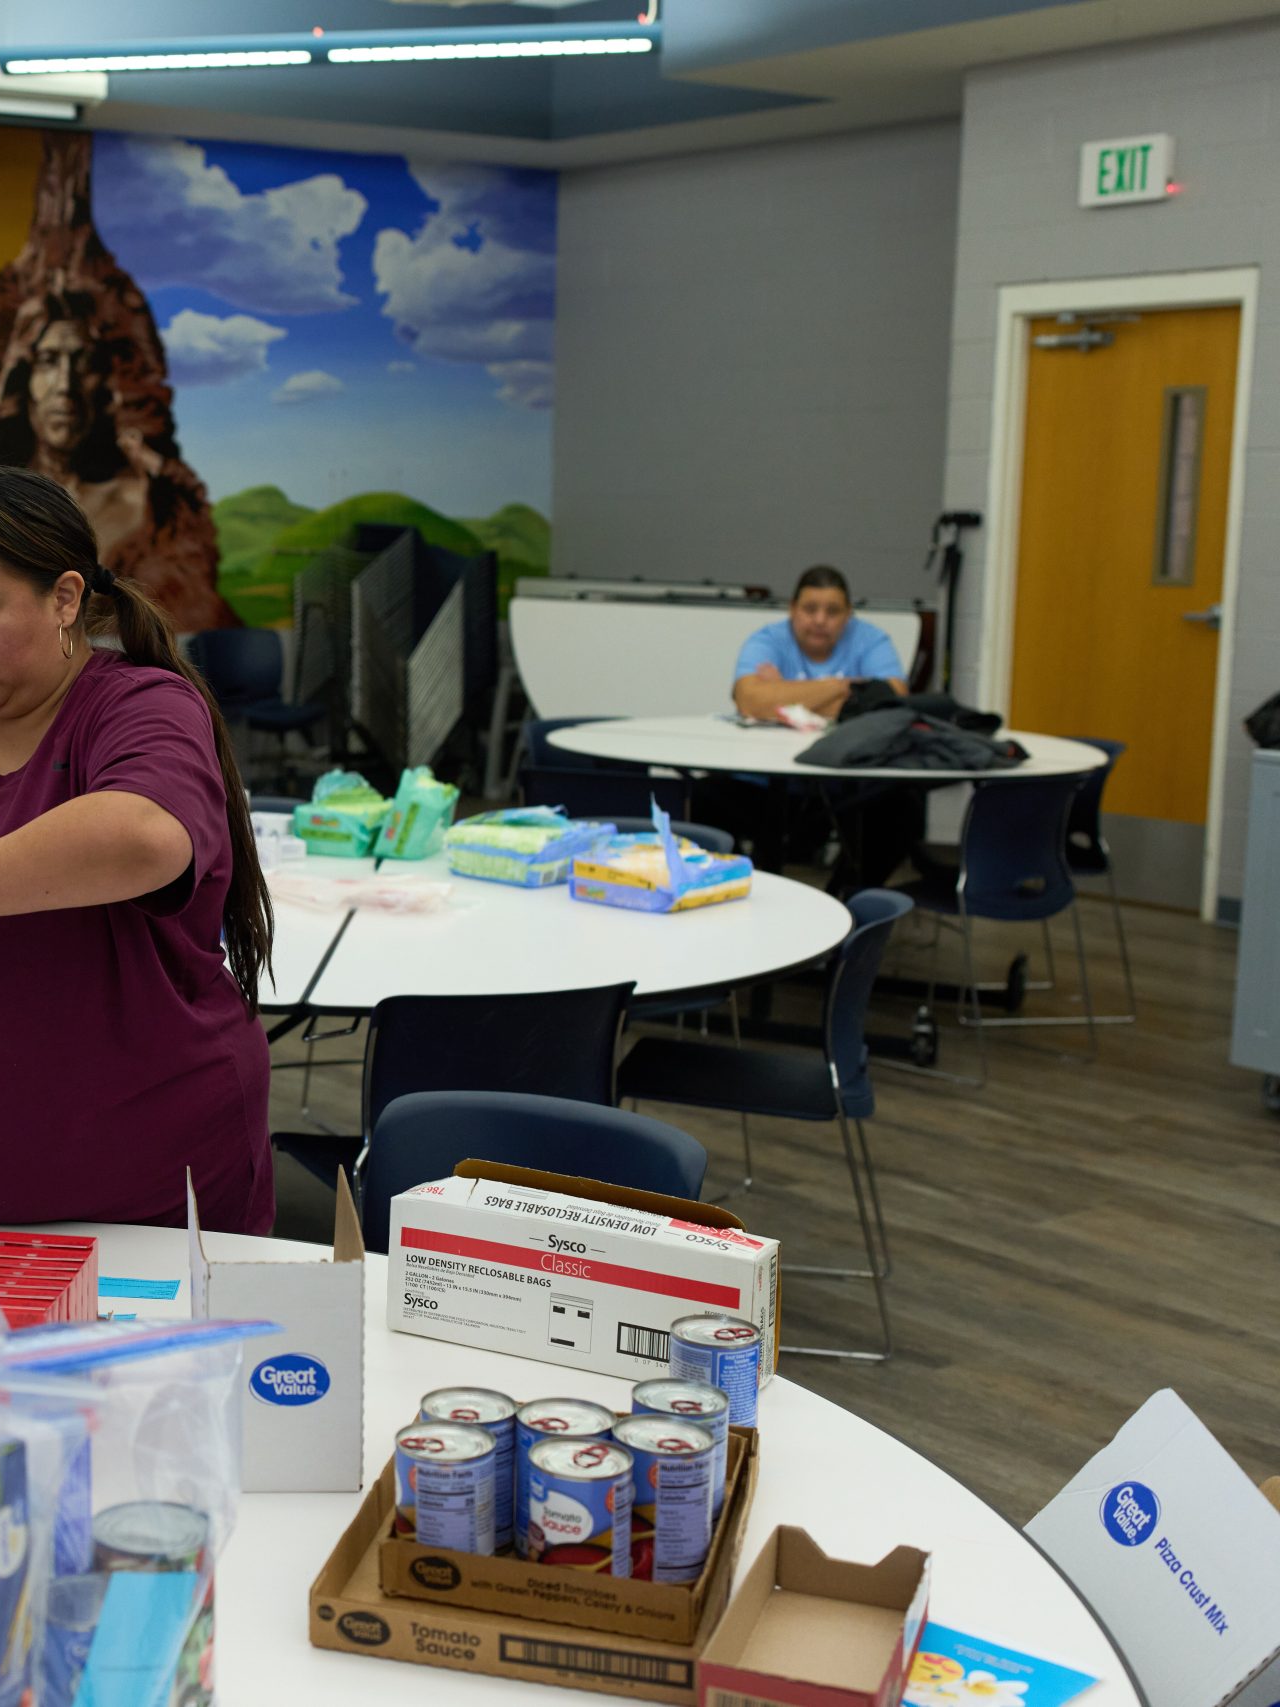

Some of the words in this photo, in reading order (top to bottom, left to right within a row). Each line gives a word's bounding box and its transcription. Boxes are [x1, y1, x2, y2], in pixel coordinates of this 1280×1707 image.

[1098, 144, 1152, 196] EXIT
[484, 1196, 513, 1210] BAGS
[514, 1201, 581, 1221] RECLOSABLE
[581, 1214, 630, 1231] DENSITY
[630, 1224, 657, 1236] LOW
[548, 1234, 586, 1254] Sysco
[686, 1234, 732, 1251] Sysco
[406, 1254, 426, 1264] LOW
[429, 1258, 466, 1271] DENSITY
[469, 1264, 524, 1283] RECLOSABLE
[527, 1275, 551, 1288] BAGS
[540, 1253, 591, 1278] Classic
[404, 1292, 438, 1310] Sysco
[260, 1366, 316, 1384] Great
[274, 1382, 317, 1395] Value
[543, 1505, 582, 1523] Tomato
[1117, 1486, 1151, 1532] Great
[541, 1515, 582, 1535] Sauce
[1112, 1505, 1137, 1540] Value
[527, 1578, 560, 1591] Diced
[564, 1582, 617, 1601] Tomatoes
[1154, 1537, 1182, 1573] Pizza
[1179, 1570, 1211, 1608] Crust
[1204, 1604, 1228, 1636] Mix
[495, 1583, 529, 1596] Green
[624, 1604, 632, 1614] &
[635, 1605, 676, 1622] Onions
[343, 1616, 382, 1632] Great
[410, 1622, 481, 1647] Tomato
[415, 1638, 476, 1661] Sauce
